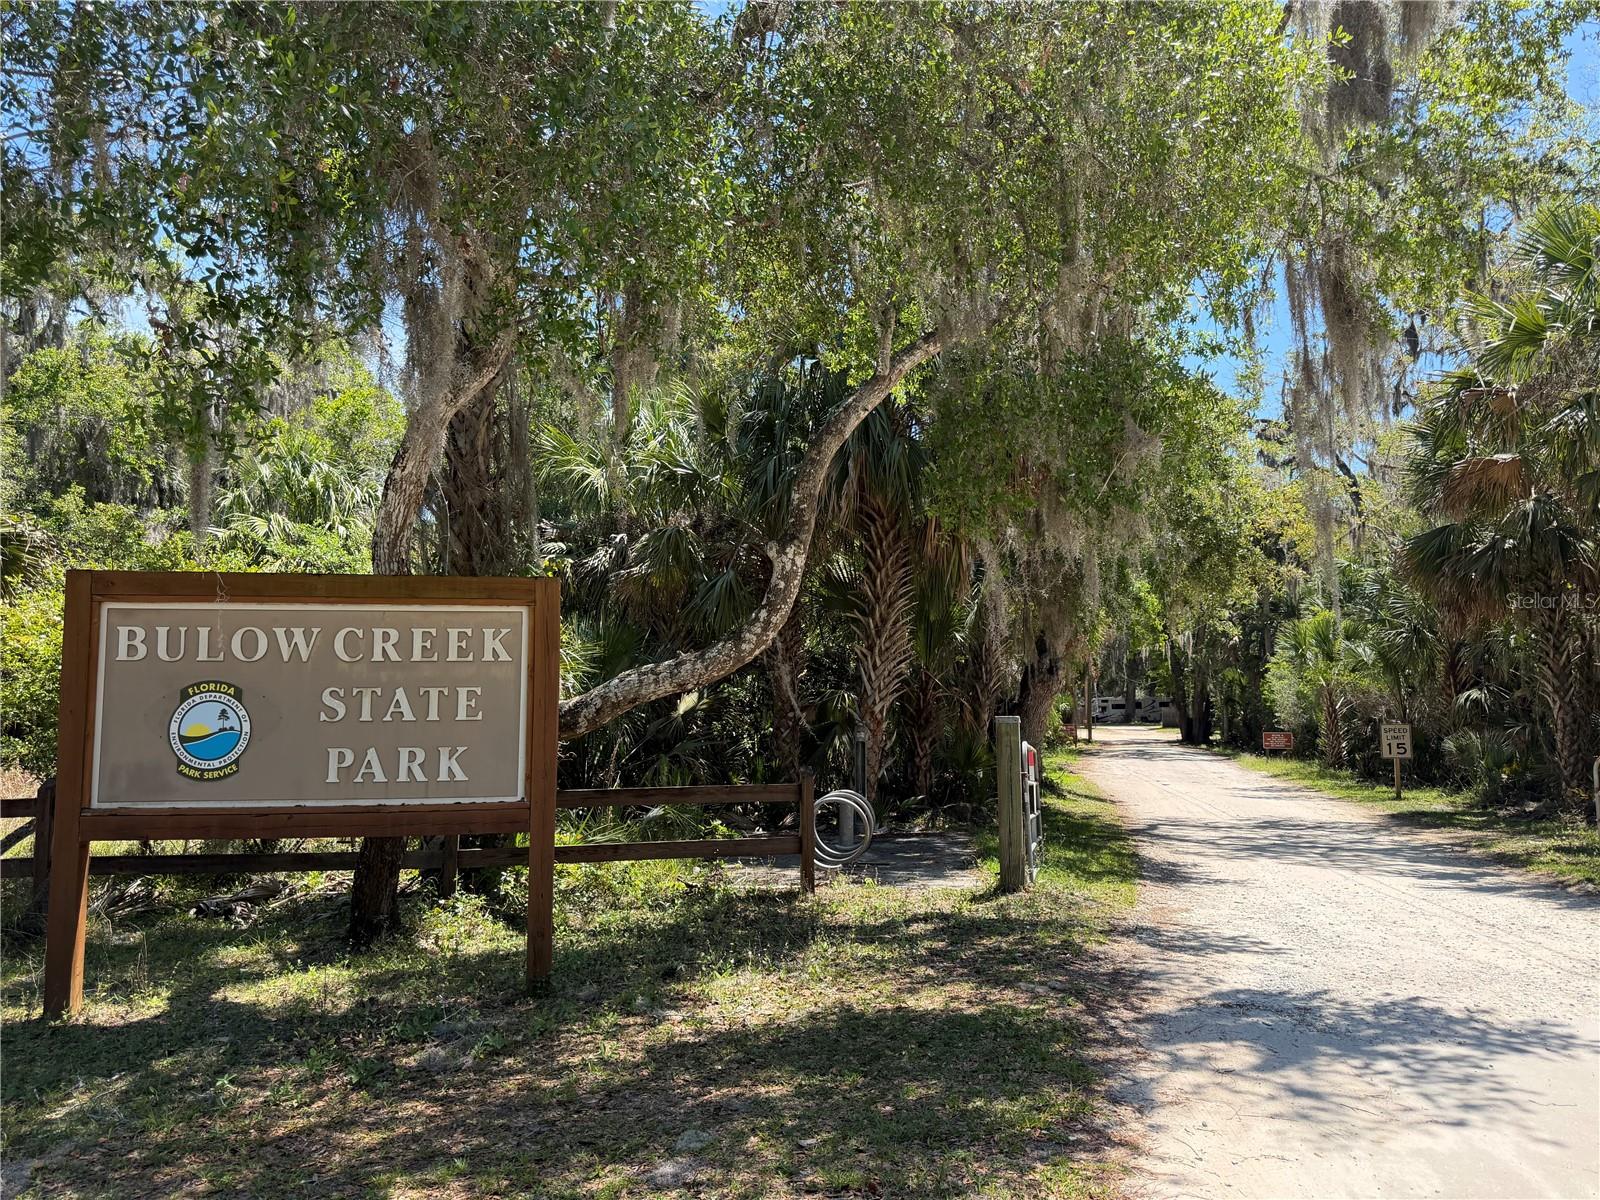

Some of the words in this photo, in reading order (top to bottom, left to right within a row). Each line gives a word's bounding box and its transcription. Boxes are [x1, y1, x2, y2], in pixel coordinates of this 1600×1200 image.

[115, 625, 321, 663] BULOW
[333, 627, 513, 663] CREEK
[188, 682, 236, 696] FLORIDA
[320, 686, 483, 723] STATE
[173, 698, 198, 724] FLORIDA
[199, 693, 243, 713] DEPARTMENT
[241, 714, 249, 723] OF
[170, 731, 216, 768] ENVIRONMENTAL
[218, 731, 249, 766] PROTECTION
[325, 746, 469, 784] PARK
[1386, 742, 1408, 755] 15
[178, 764, 201, 779] PARK
[203, 763, 239, 779] SERVICE
